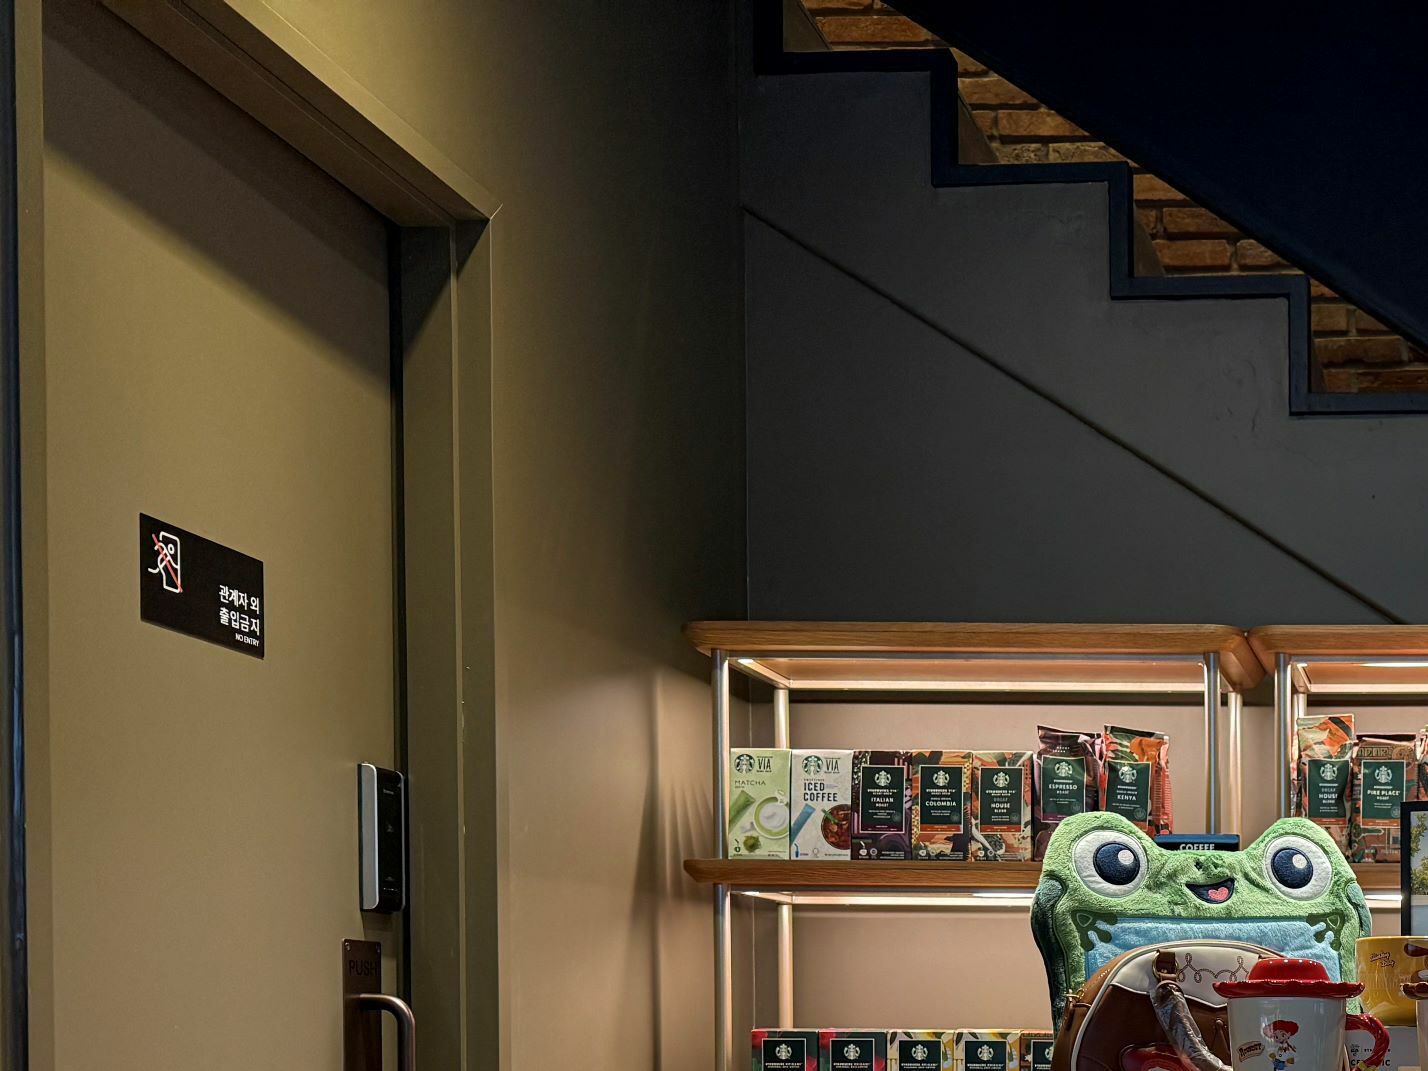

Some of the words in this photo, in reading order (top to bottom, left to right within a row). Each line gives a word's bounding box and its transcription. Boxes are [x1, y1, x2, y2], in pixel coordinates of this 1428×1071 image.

[219, 585, 248, 610] 관계자
[250, 597, 259, 614] 외
[219, 607, 260, 635] 출입금지
[235, 633, 243, 642] NO
[243, 636, 259, 647] ENTRY
[757, 758, 771, 770] VIA
[826, 759, 839, 771] VIA
[803, 782, 825, 791] ICED
[803, 792, 838, 802] COFFEE
